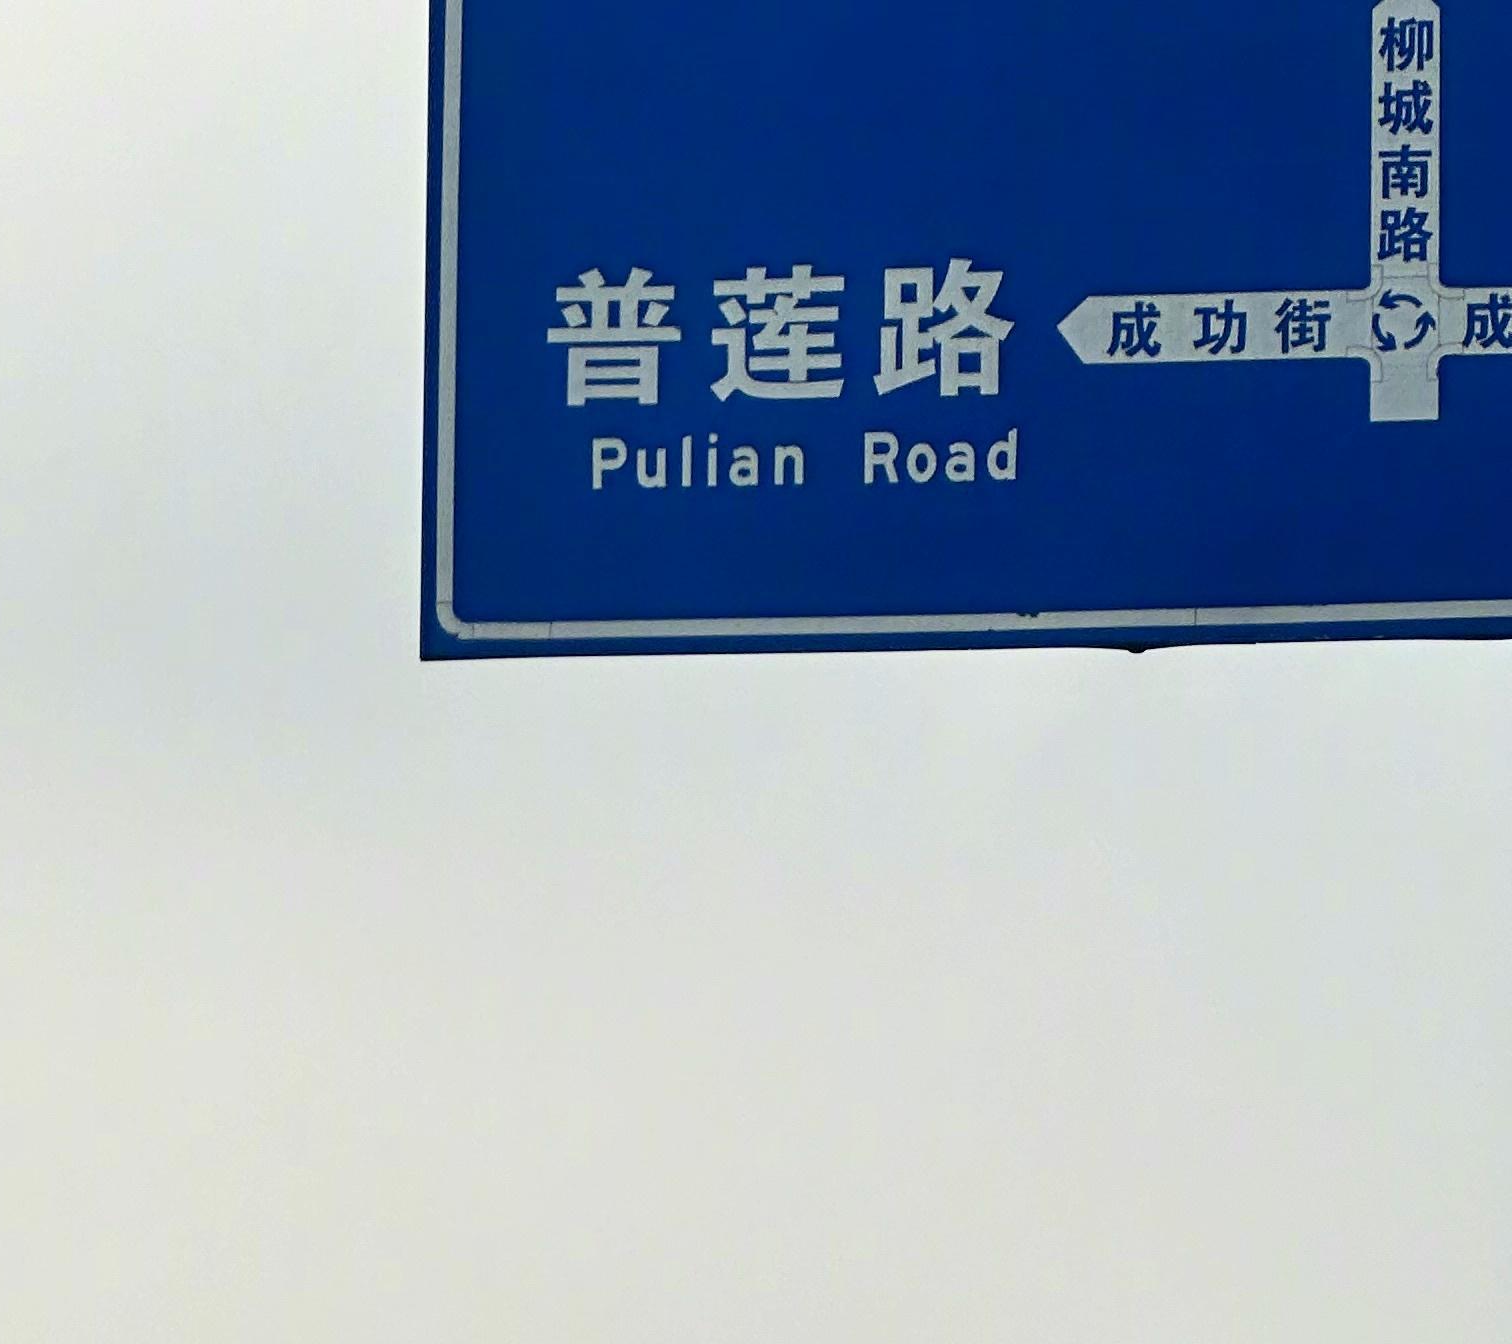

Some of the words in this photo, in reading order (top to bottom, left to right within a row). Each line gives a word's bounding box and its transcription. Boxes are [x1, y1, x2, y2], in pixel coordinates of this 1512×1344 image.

[1377, 15, 1434, 264] 柳城南路
[547, 258, 1014, 407] 普莲路
[1105, 297, 1332, 357] 成功街
[591, 431, 805, 491] Pulian
[863, 427, 1020, 484] Road
